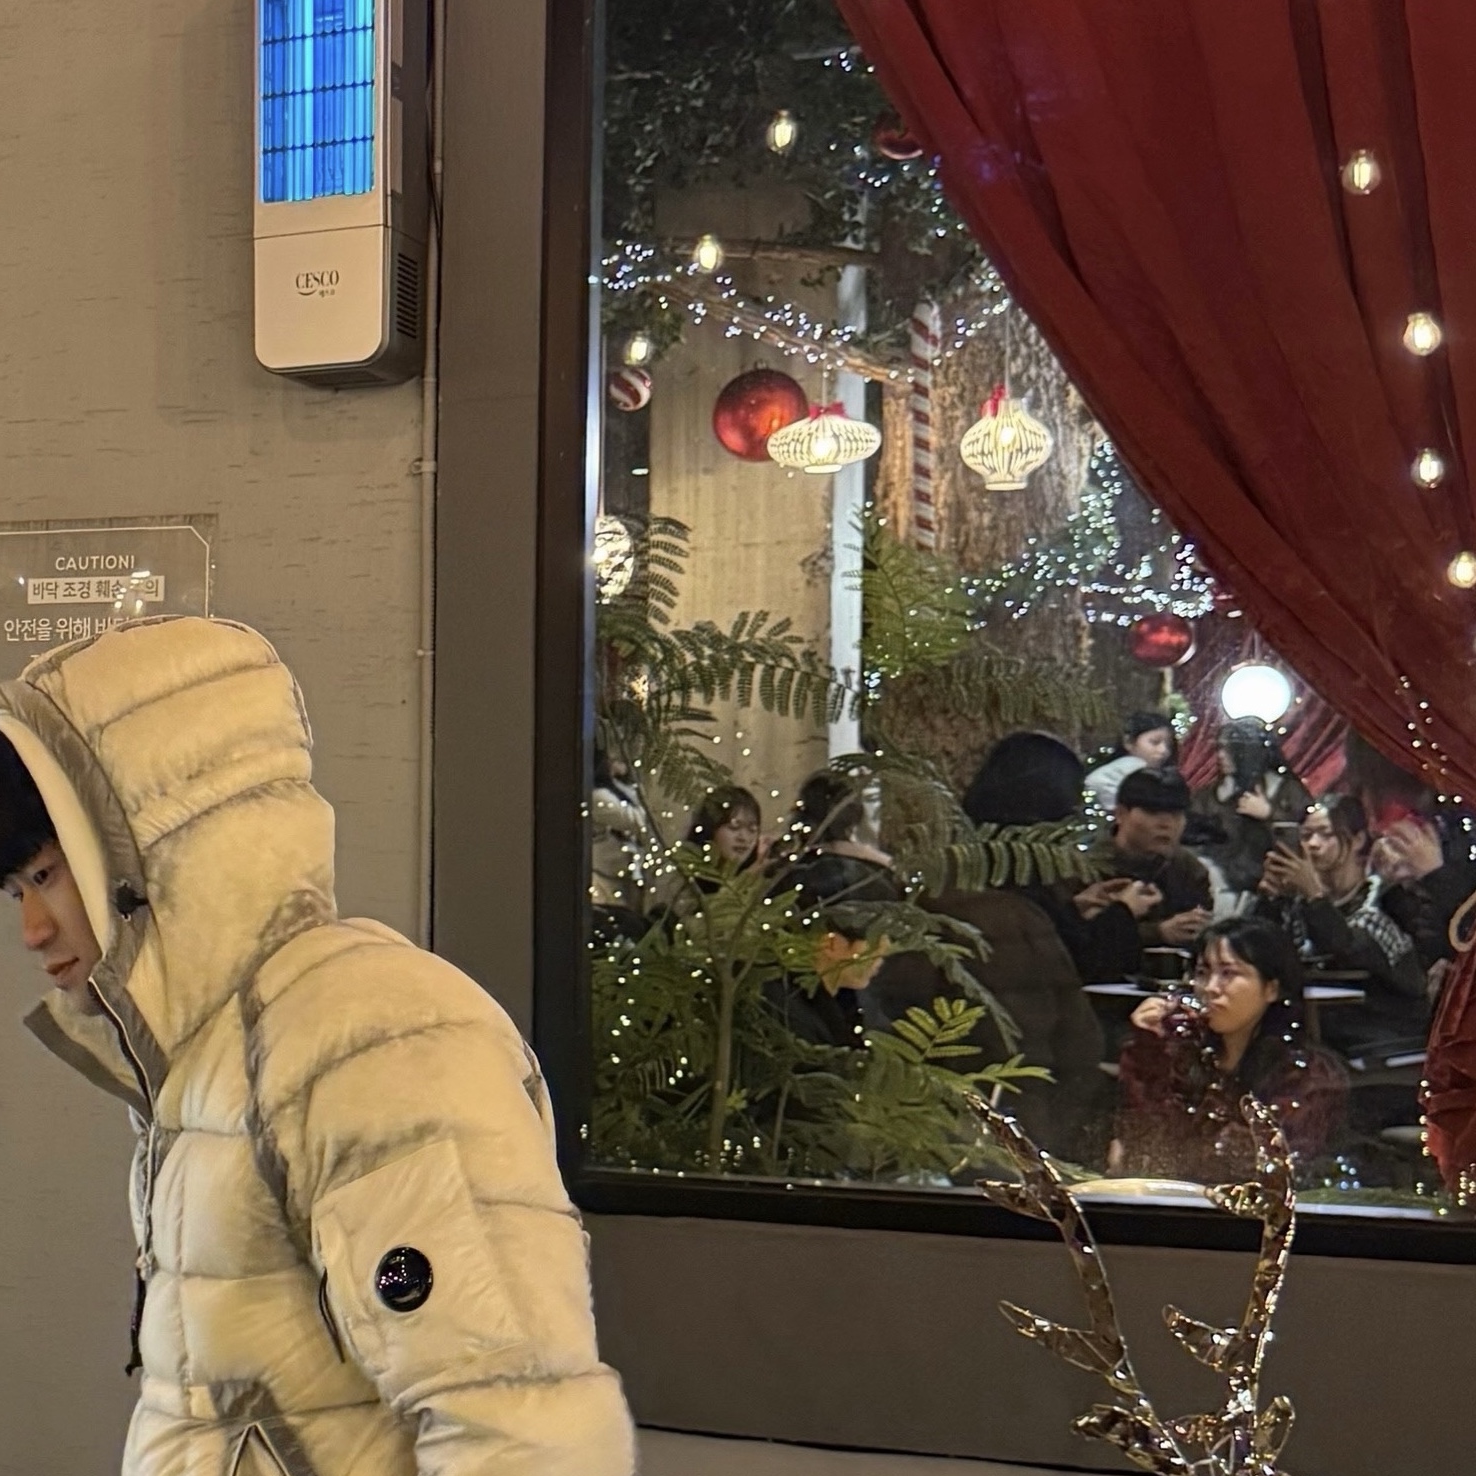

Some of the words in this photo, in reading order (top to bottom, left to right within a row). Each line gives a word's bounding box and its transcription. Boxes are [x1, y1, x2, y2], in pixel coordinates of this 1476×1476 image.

[296, 270, 339, 289] CESCO
[32, 581, 60, 600] 바닥
[62, 580, 91, 600] 조경
[4, 618, 52, 641] 안전을
[55, 616, 91, 641] 위해
